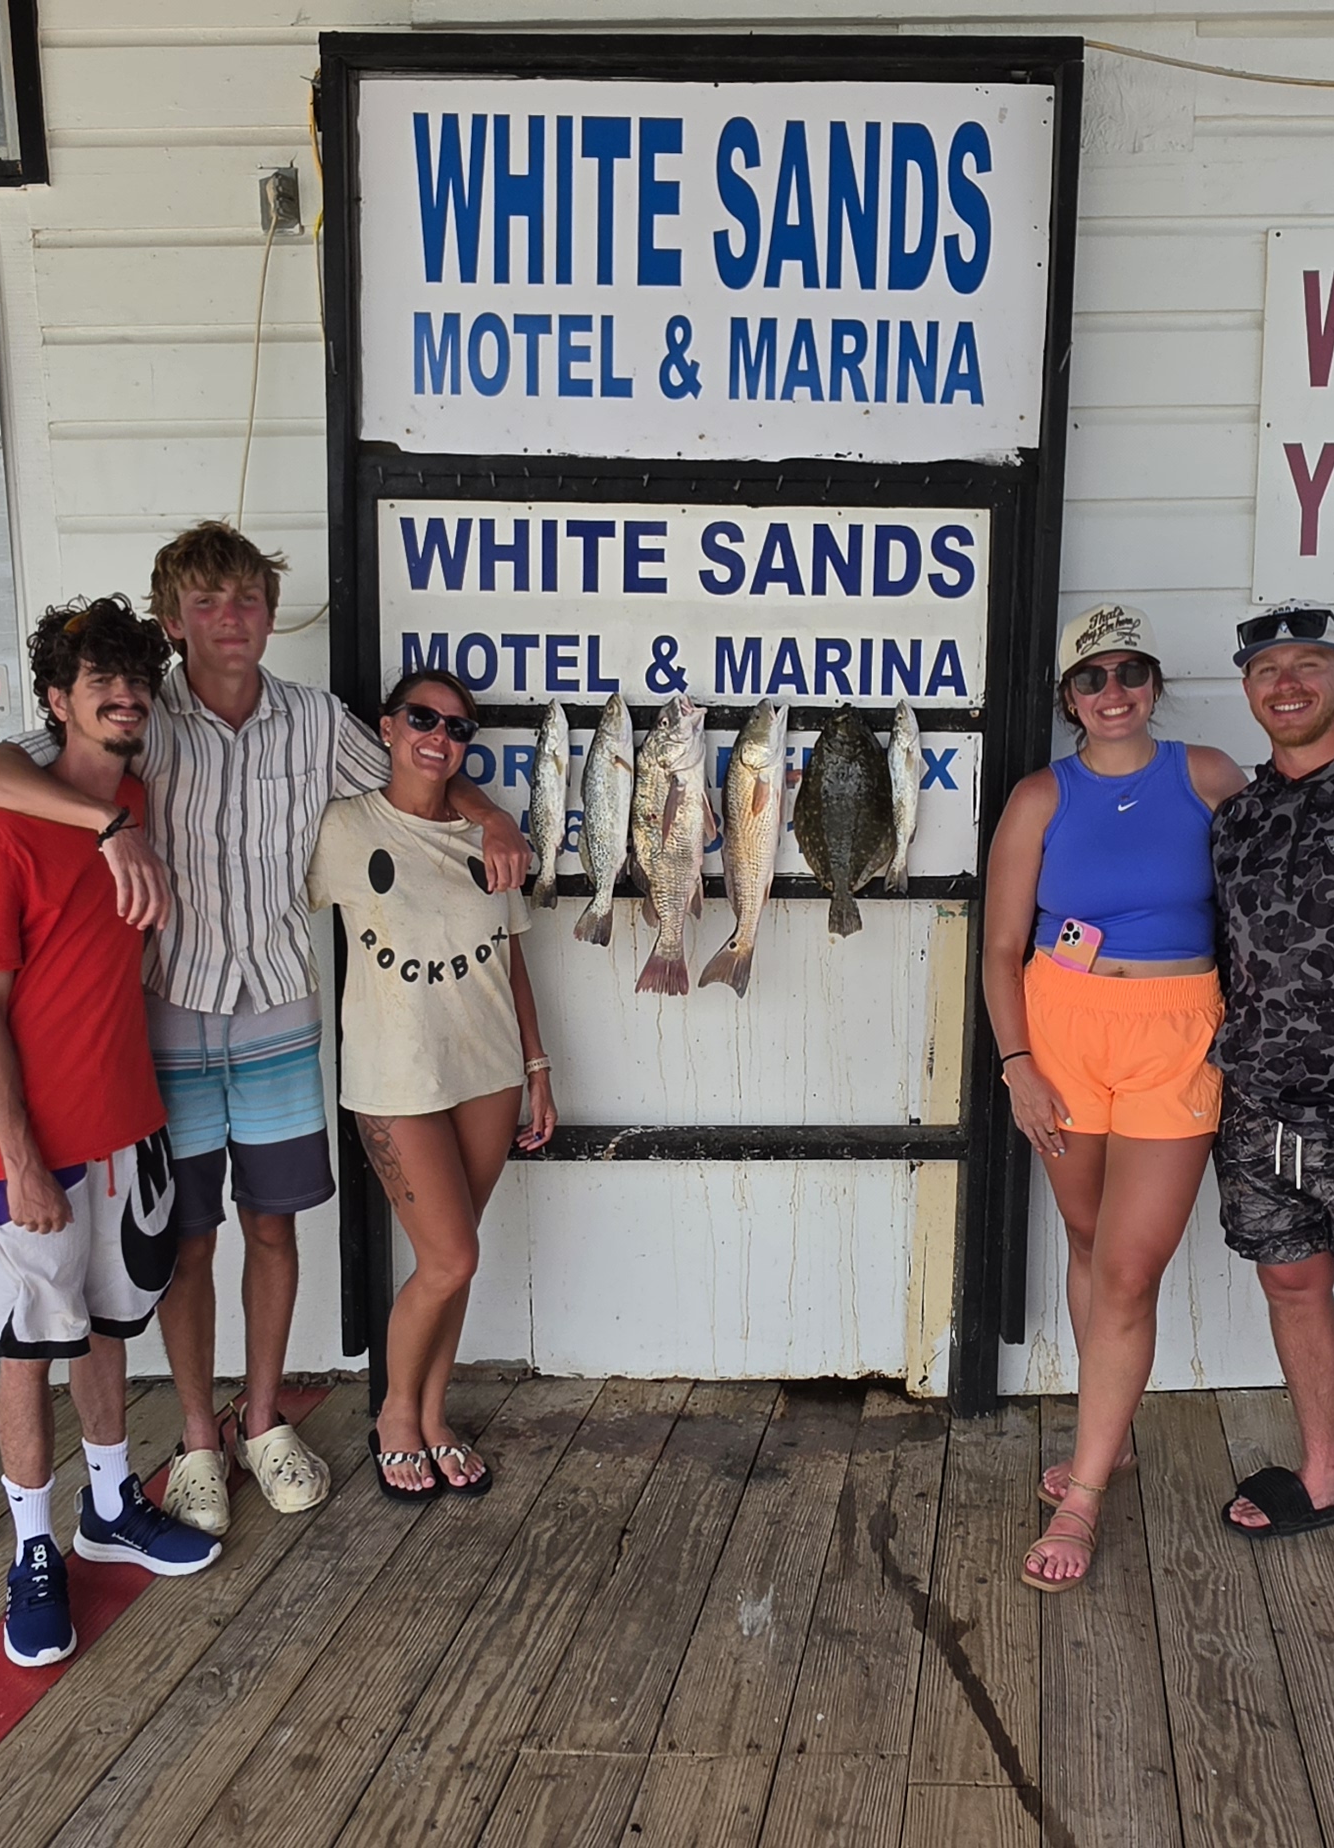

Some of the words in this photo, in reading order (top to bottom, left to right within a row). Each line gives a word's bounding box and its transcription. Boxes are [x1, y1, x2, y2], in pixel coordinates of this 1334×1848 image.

[412, 111, 683, 288] WHITE
[712, 115, 993, 294] SANDS
[412, 311, 634, 399] MOTEL
[659, 314, 703, 400] &
[728, 317, 985, 406] MARINA
[399, 516, 668, 594] WHITE
[698, 520, 976, 599] SANDS
[401, 631, 620, 694] MOTEL
[645, 634, 688, 695] &
[714, 636, 968, 698] MARINA
[360, 926, 508, 985] ROCKBOX
